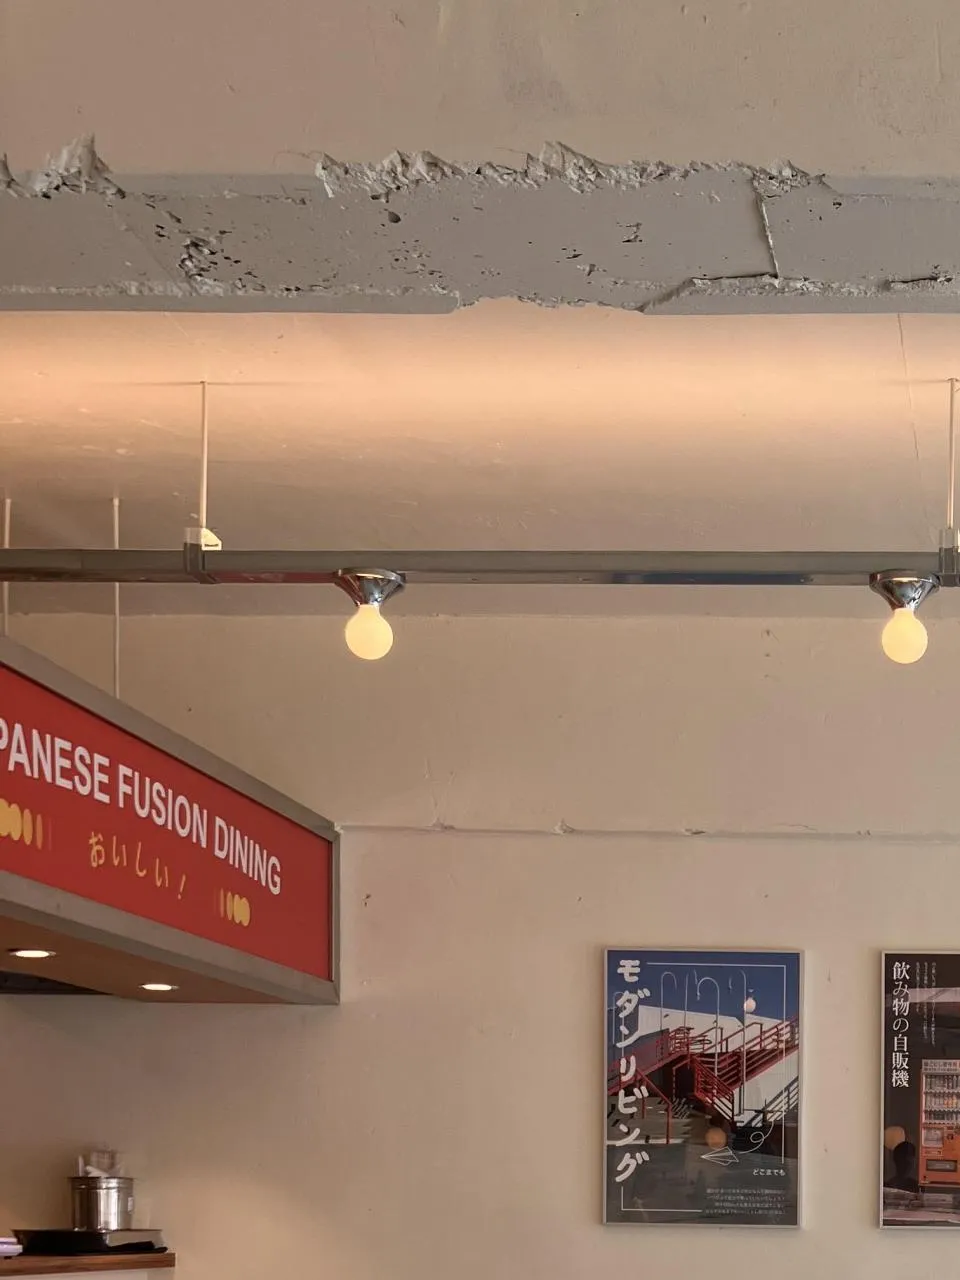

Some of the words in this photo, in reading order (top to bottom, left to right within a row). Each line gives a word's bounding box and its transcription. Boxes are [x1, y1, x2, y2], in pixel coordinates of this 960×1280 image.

[117, 764, 207, 848] FUSION
[214, 816, 281, 895] DINING
[615, 959, 650, 1183] モダンリビング
[892, 961, 910, 1088] 飲み物の自販機
[752, 1168, 786, 1176] どこまでも
